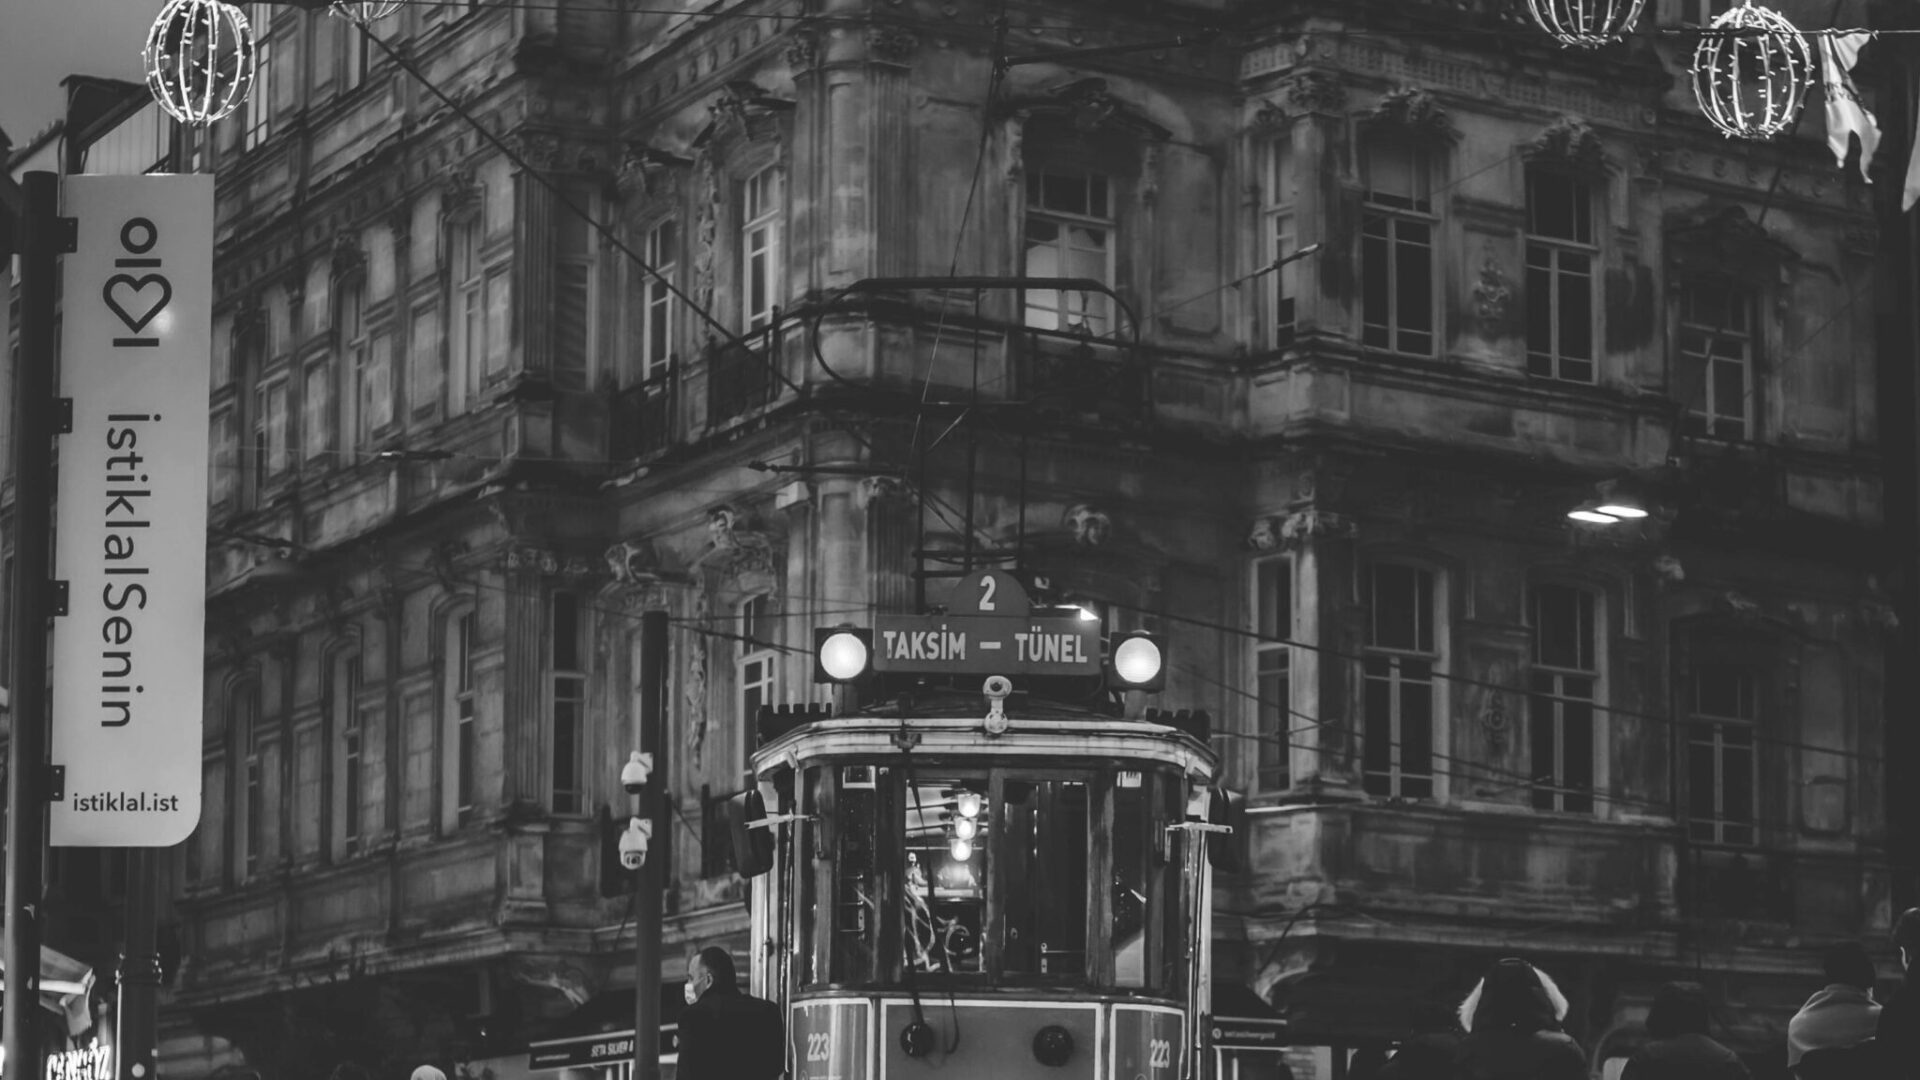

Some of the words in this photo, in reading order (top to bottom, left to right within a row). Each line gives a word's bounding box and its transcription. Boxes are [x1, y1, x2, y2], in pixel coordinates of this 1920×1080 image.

[979, 575, 996, 611] 2
[883, 624, 966, 660] TAKSİM
[1014, 625, 1088, 663] TÜNEL
[73, 791, 179, 812] istiklal.ist
[807, 1032, 829, 1062] 223
[1149, 1038, 1170, 1068] 223
